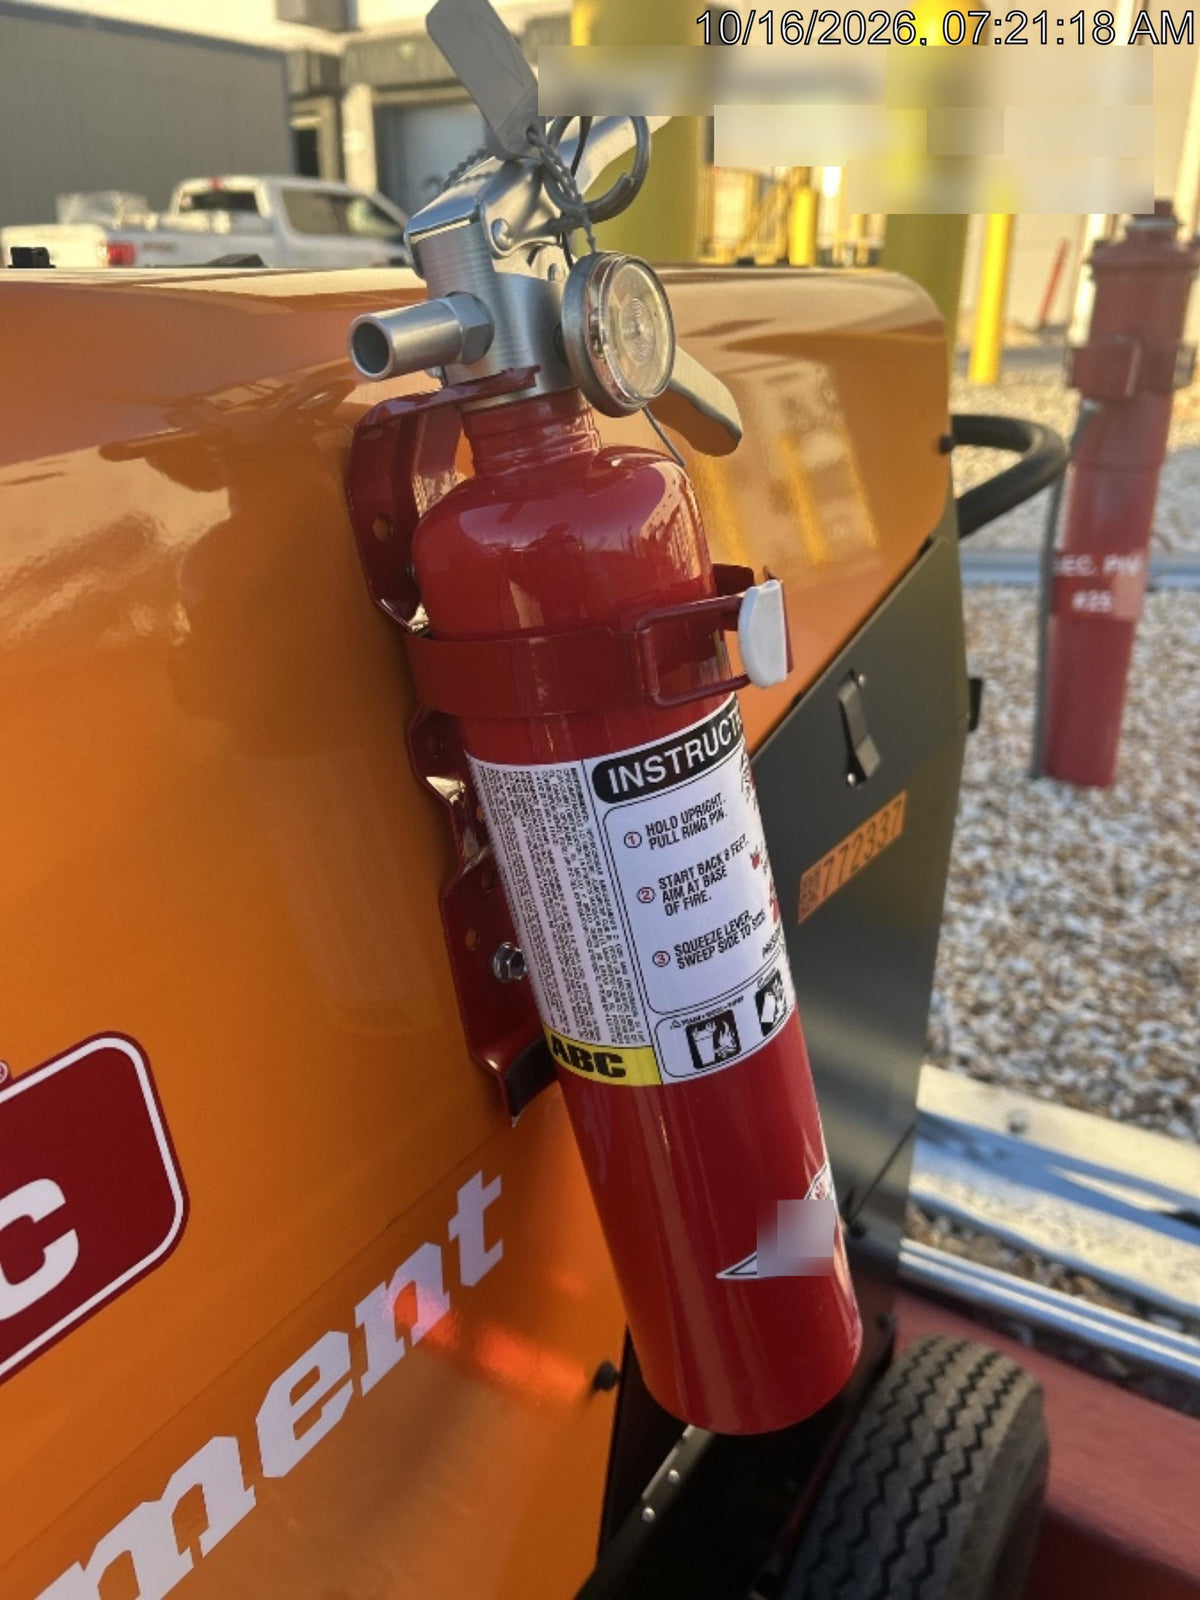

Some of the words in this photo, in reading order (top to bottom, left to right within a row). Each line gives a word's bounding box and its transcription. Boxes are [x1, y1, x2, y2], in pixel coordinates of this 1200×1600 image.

[645, 815, 678, 837] HOLD
[680, 792, 726, 825] UPRIGHT.
[648, 829, 681, 850] PULL
[681, 816, 708, 839] RING
[708, 806, 728, 825] PIN.
[659, 866, 695, 890] START
[696, 853, 725, 875] BACK
[662, 885, 685, 903] AIM
[687, 878, 700, 895] AT
[702, 864, 728, 888] BASE
[664, 900, 680, 916] OF
[682, 889, 712, 910] FIRE.
[674, 927, 723, 957] SQUEEZE
[676, 944, 716, 970] SWEEP
[717, 931, 741, 954] SIDE
[740, 924, 751, 939] TO
[551, 1034, 627, 1078] ABC
